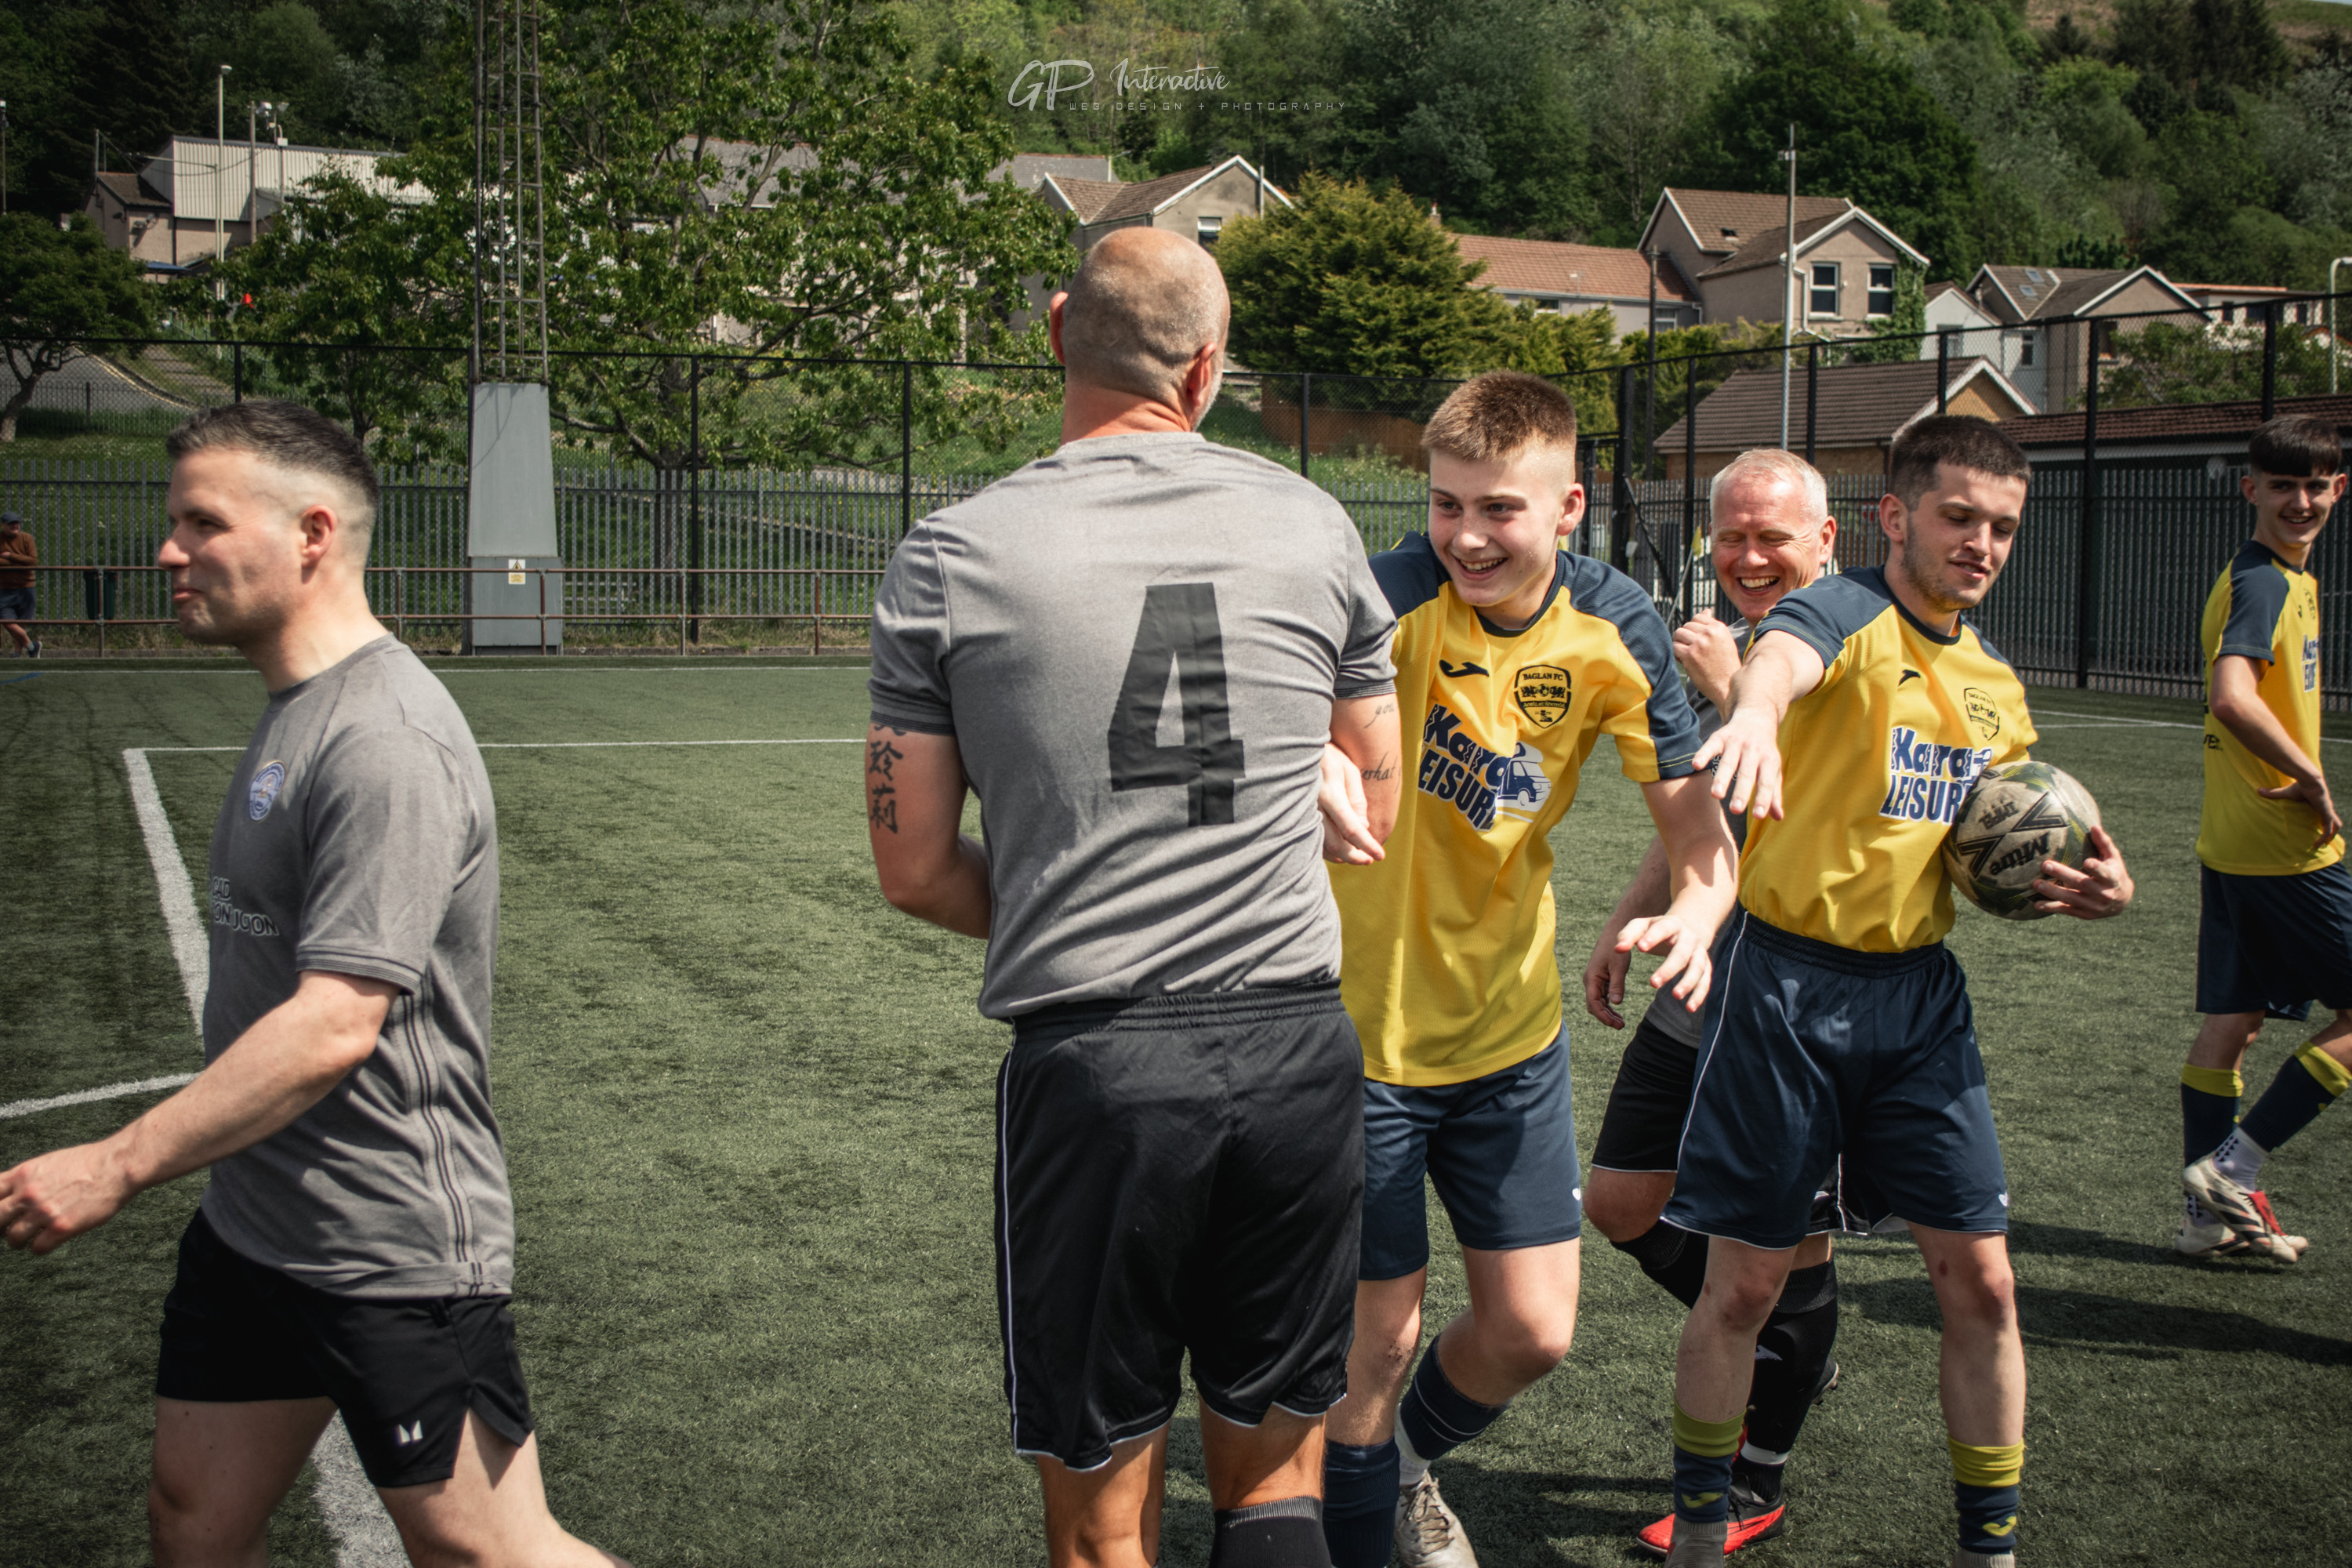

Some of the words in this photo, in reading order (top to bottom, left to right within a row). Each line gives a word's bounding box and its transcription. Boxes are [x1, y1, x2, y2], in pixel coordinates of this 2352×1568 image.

[1107, 582, 1246, 827] 4
[1890, 726, 1975, 779] Kara
[1417, 747, 1497, 832] EISUR
[1878, 771, 1973, 826] LEISUR
[1989, 831, 2050, 876] Mitre
